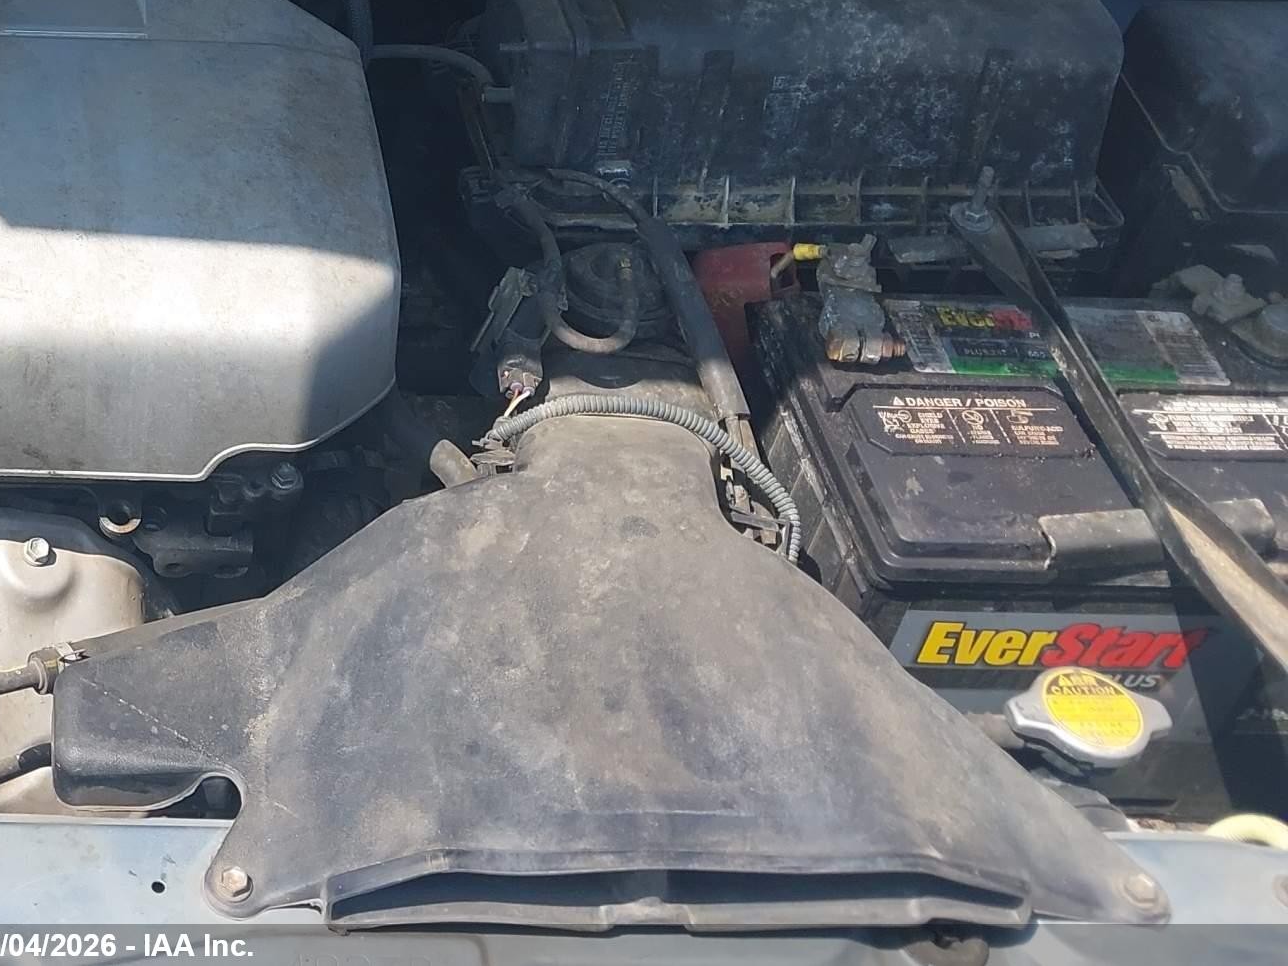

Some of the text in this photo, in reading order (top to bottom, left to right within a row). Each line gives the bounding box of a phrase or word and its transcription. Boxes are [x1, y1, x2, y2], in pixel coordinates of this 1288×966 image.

[905, 397, 962, 407] DANGER
[974, 399, 1027, 408] POISON
[916, 620, 1208, 669] EverStart
[1050, 685, 1115, 696] CAUTION
